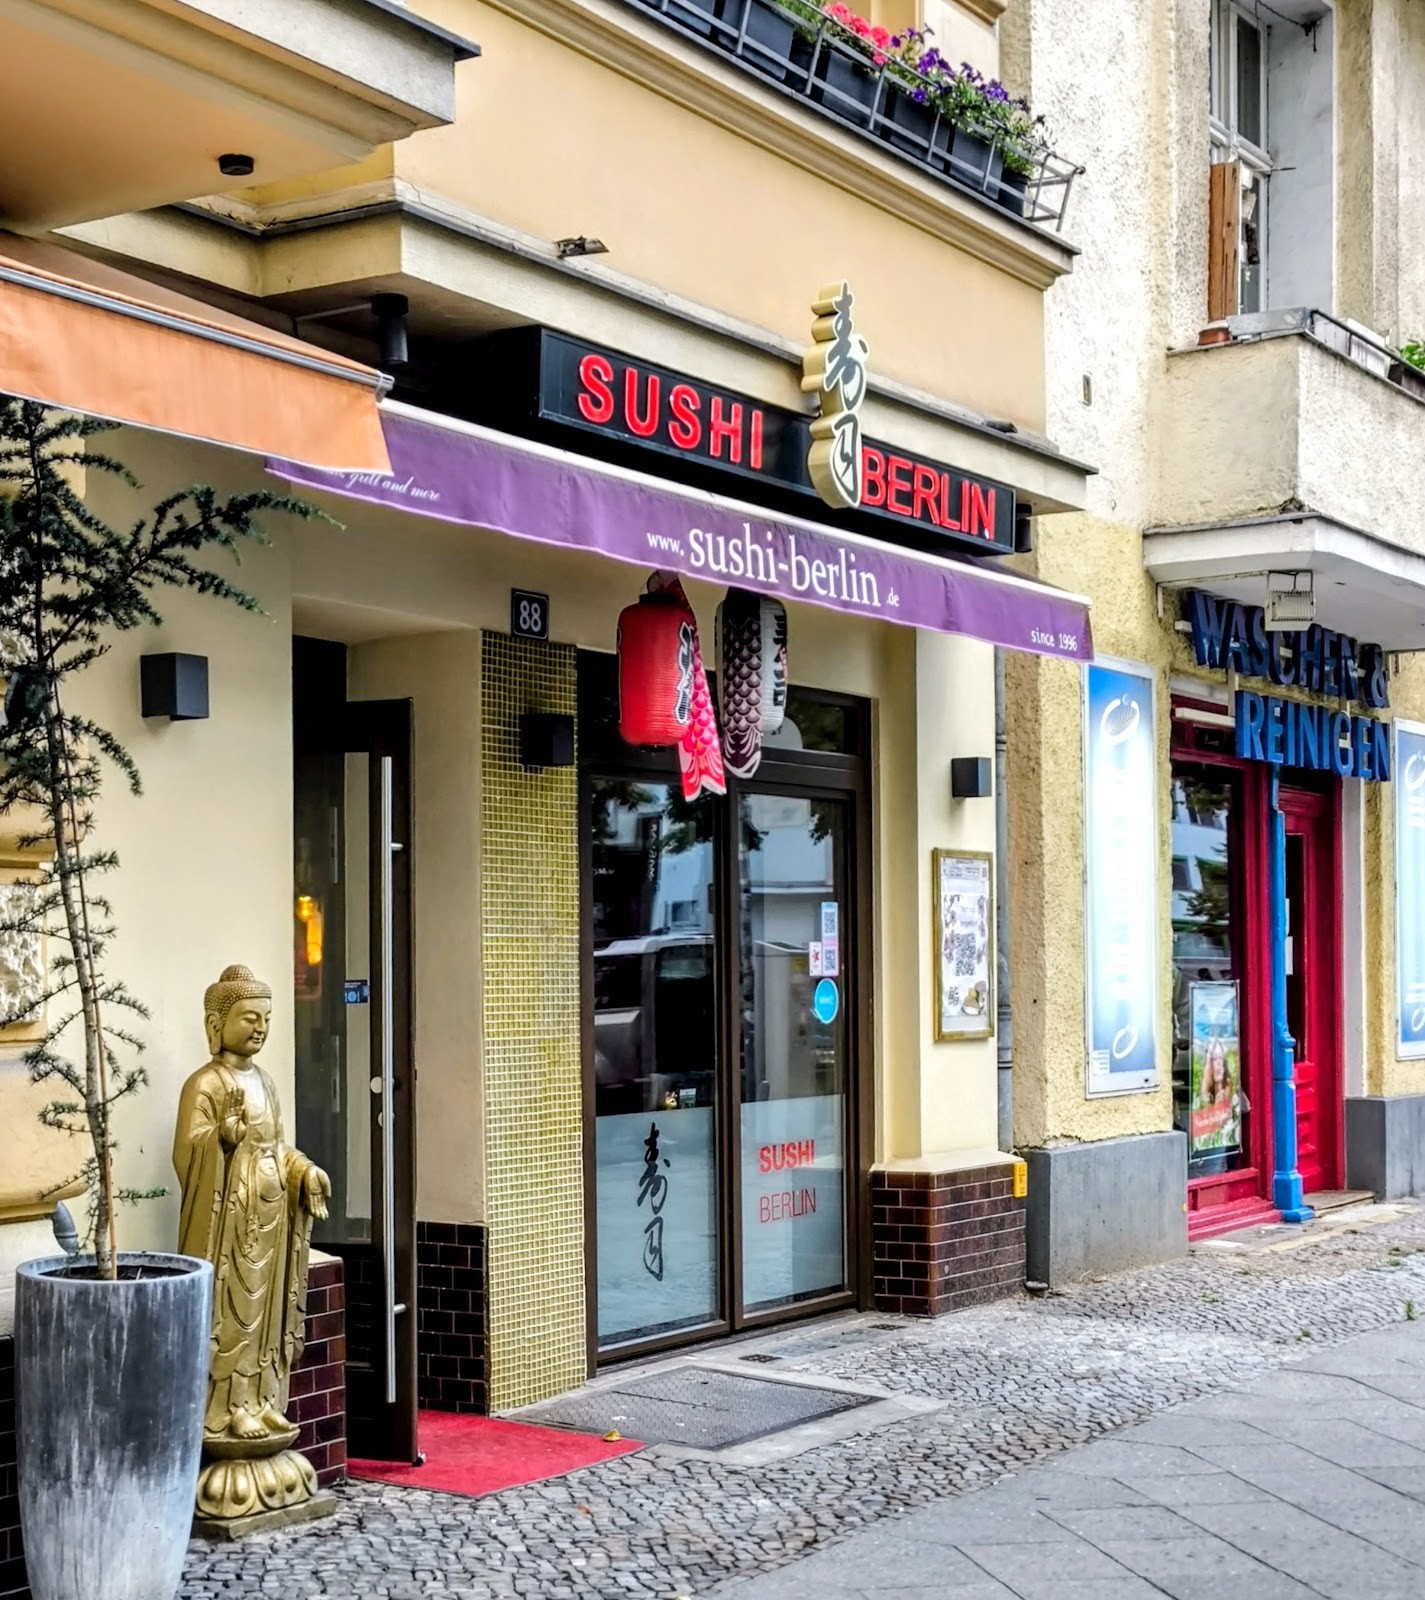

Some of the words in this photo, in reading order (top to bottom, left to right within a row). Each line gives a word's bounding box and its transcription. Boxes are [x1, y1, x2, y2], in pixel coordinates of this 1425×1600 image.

[577, 354, 764, 470] SUSHI
[861, 446, 996, 540] BERLIN
[381, 476, 414, 494] and
[410, 486, 440, 501] more
[519, 600, 542, 634] 88
[1031, 626, 1055, 647] since
[1059, 633, 1078, 651] 1996
[1187, 590, 1359, 700] WASCHEN
[1362, 643, 1390, 709] &
[1235, 690, 1391, 781] REINIGEN
[759, 1139, 815, 1173] SUSHI
[759, 1188, 816, 1223] BERLIN
